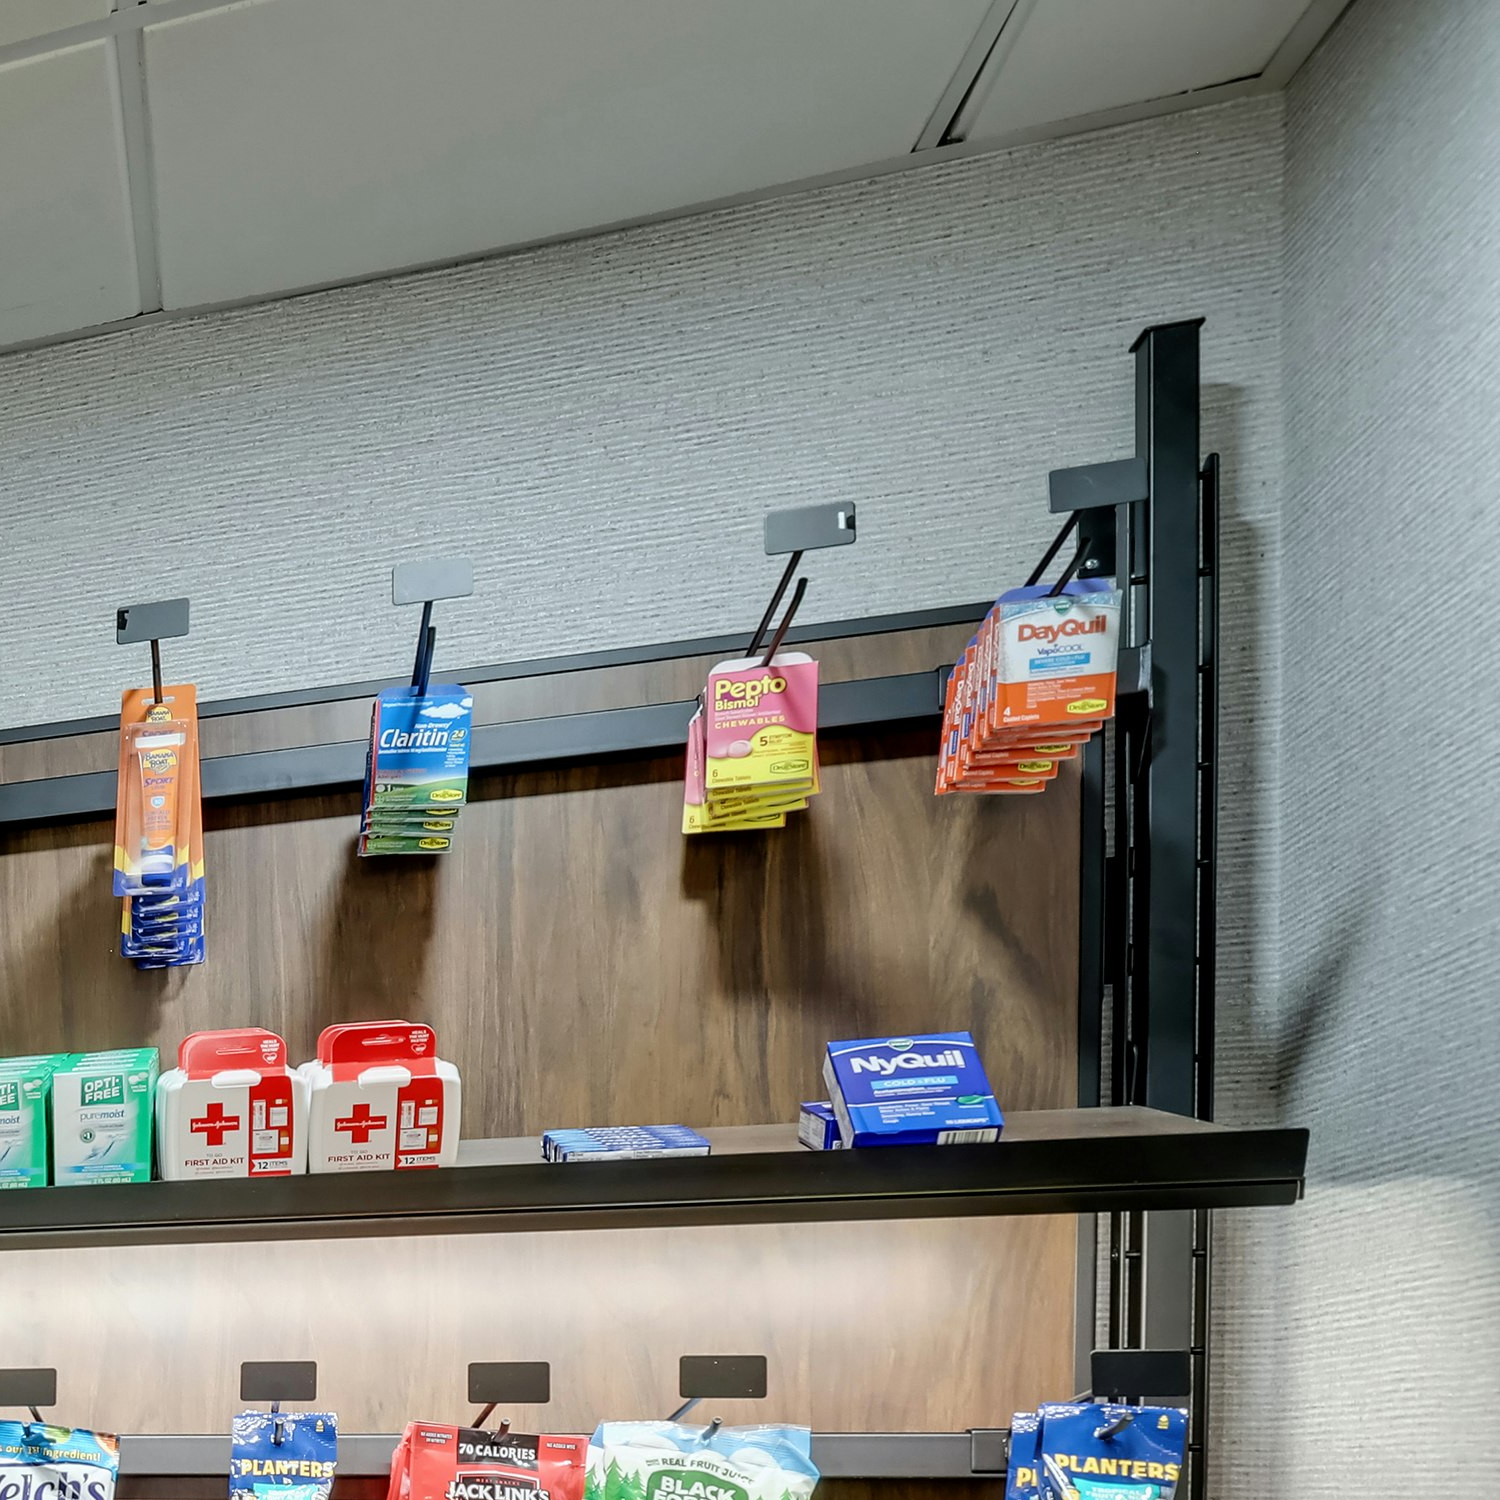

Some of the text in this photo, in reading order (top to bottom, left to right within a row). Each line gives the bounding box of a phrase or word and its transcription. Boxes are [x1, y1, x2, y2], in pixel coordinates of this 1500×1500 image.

[1017, 615, 1107, 643] DayQuil
[715, 675, 787, 700] Pepto
[715, 697, 759, 711] Bismol
[1003, 706, 1011, 715] 4
[715, 715, 785, 729] CHEWABLES
[381, 729, 448, 748] Claritin
[760, 736, 768, 746] 5
[145, 752, 173, 763] BANANA
[150, 759, 169, 770] BOAT
[850, 1050, 966, 1075] NyQuil
[884, 1079, 915, 1087] COLD
[85, 1086, 120, 1103] FREE
[80, 1109, 125, 1122] puremoist
[184, 1157, 245, 1167] FIRST AID KIT
[257, 1161, 269, 1170] 12
[327, 1154, 355, 1163] FIRST
[404, 1156, 416, 1165] 12
[5, 1445, 24, 1454] our
[459, 1442, 536, 1461] 70 CALORIES
[241, 1459, 335, 1479] PLANTERS
[662, 1457, 721, 1474] REAL FRUIT
[1053, 1453, 1181, 1482] PLANTERS
[445, 1481, 495, 1500] JACK
